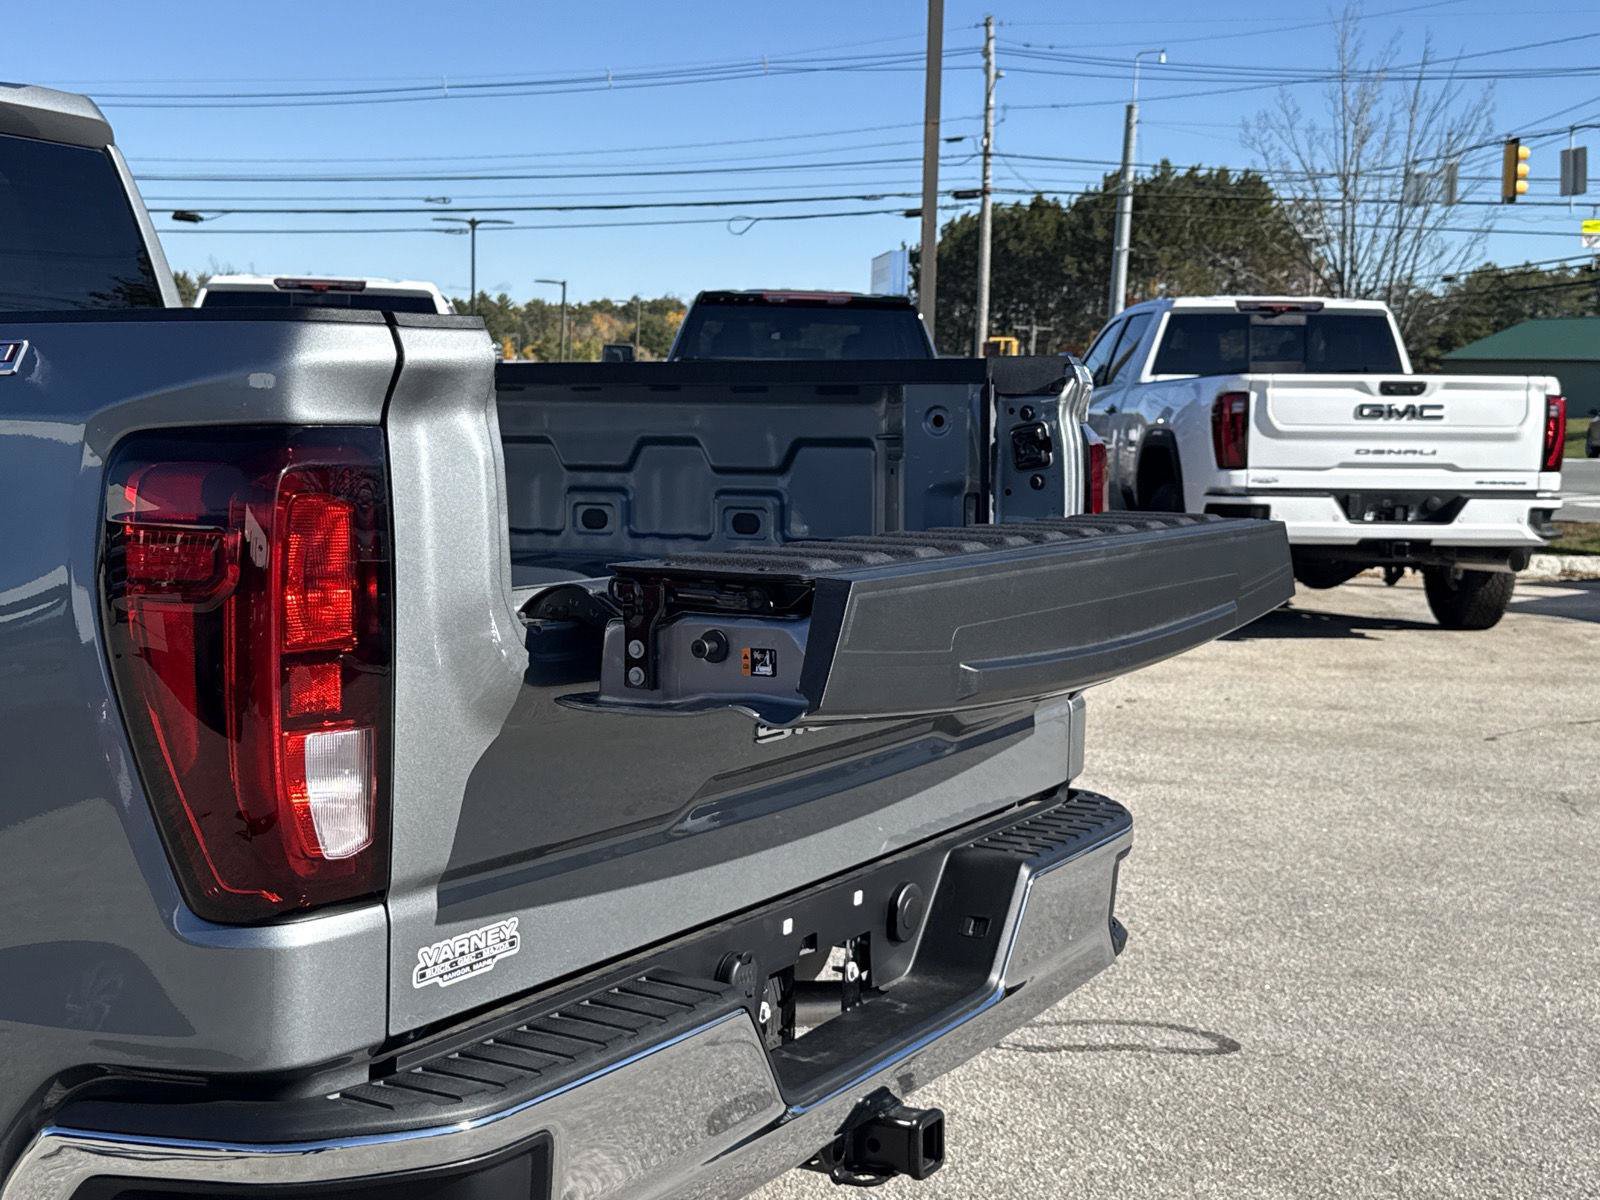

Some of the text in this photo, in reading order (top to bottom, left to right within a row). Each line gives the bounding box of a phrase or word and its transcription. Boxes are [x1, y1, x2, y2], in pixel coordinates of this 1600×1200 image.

[1355, 403, 1444, 420] GMC
[1355, 448, 1437, 456] DENALI
[420, 920, 517, 968] VARNEY
[426, 941, 509, 978] BUICK GMC MAZDA
